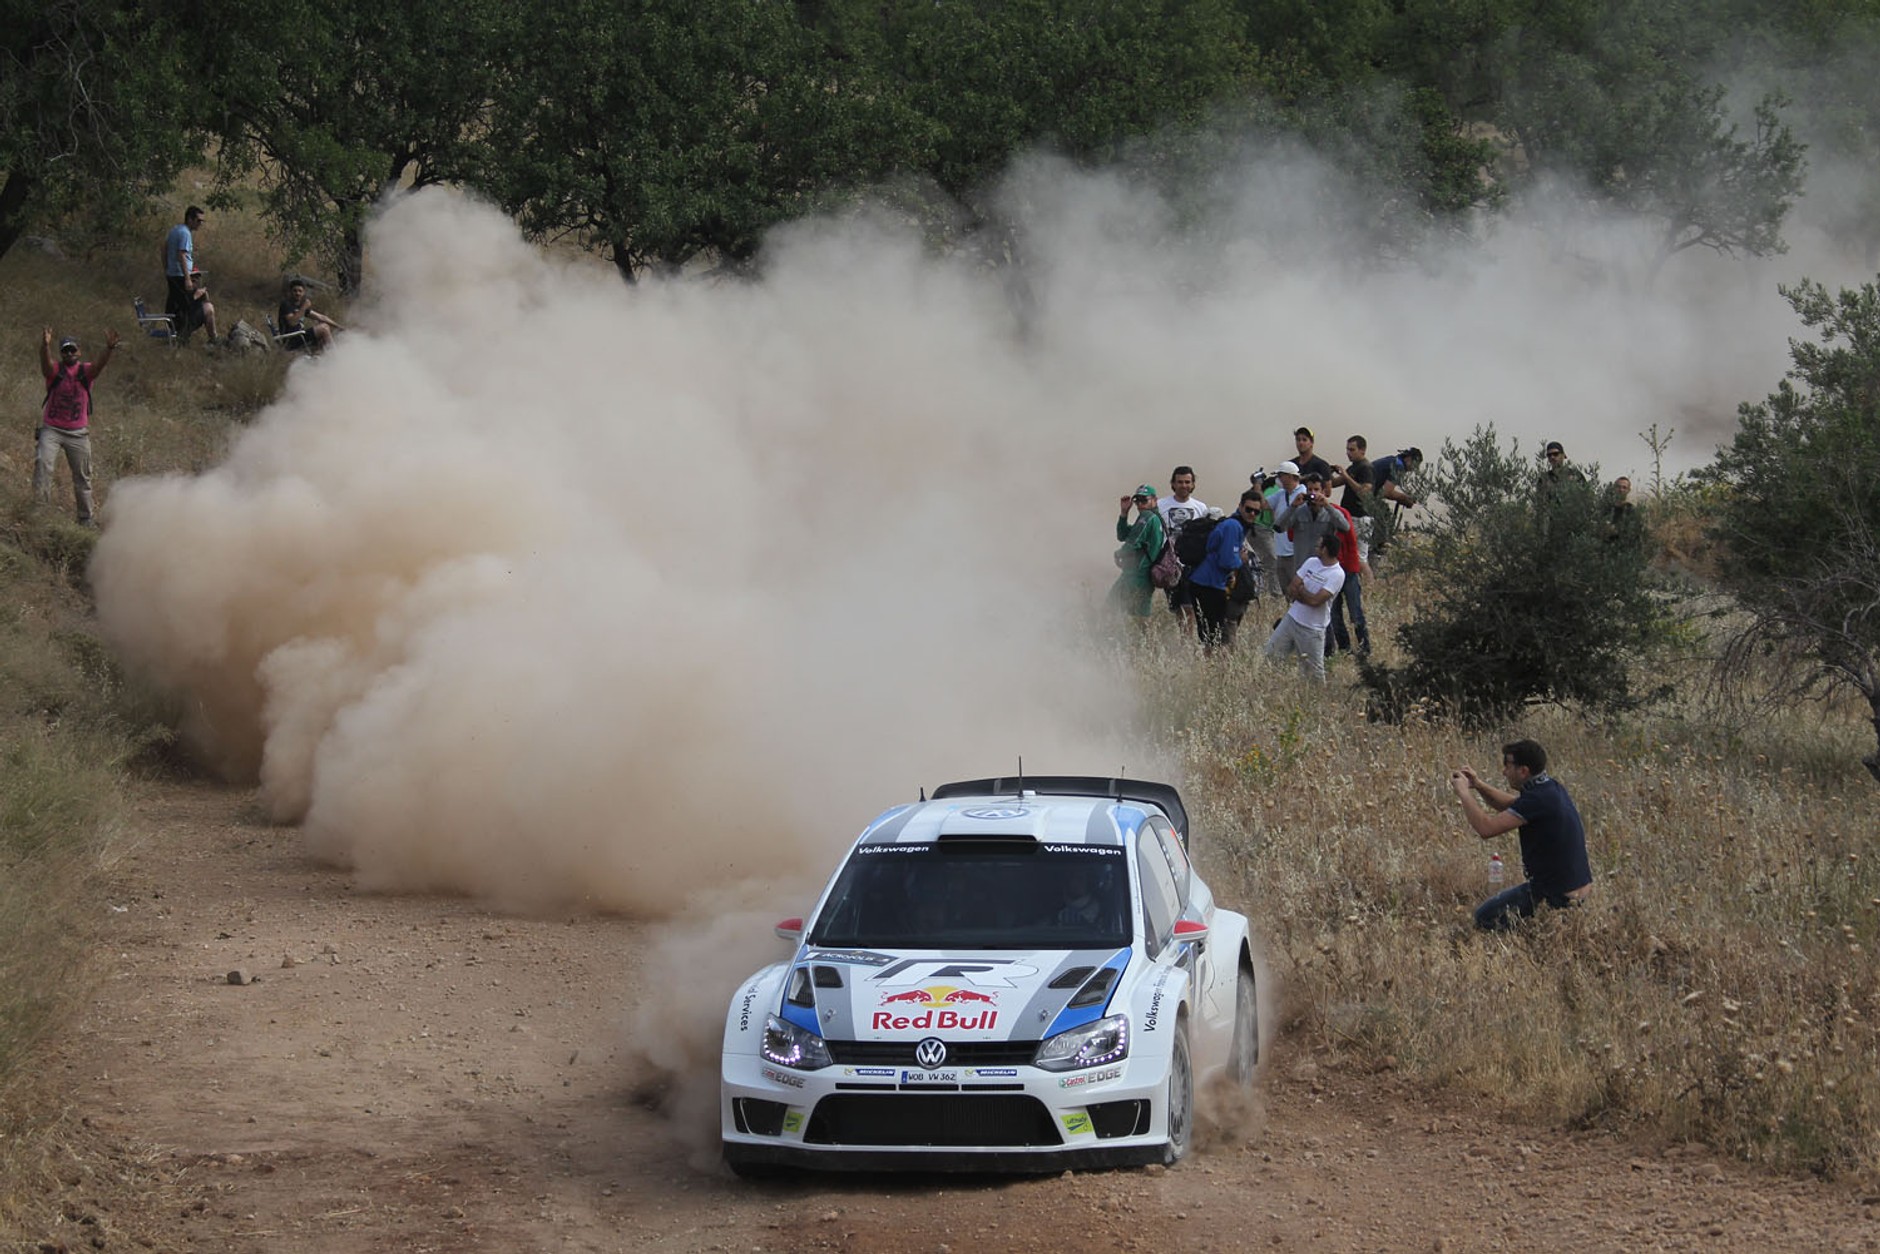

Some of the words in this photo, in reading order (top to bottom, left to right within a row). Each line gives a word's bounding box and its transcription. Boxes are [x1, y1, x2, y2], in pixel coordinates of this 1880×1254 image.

[859, 846, 929, 854] Volkswagen
[1044, 845, 1122, 855] Volkswagen
[740, 994, 757, 1031] Services
[872, 1010, 933, 1030] Red
[937, 1010, 998, 1030] Bull
[916, 1039, 947, 1068] VW
[775, 1072, 806, 1088] EDGE
[908, 1073, 924, 1081] WOB
[1087, 1067, 1121, 1084] EDGE
